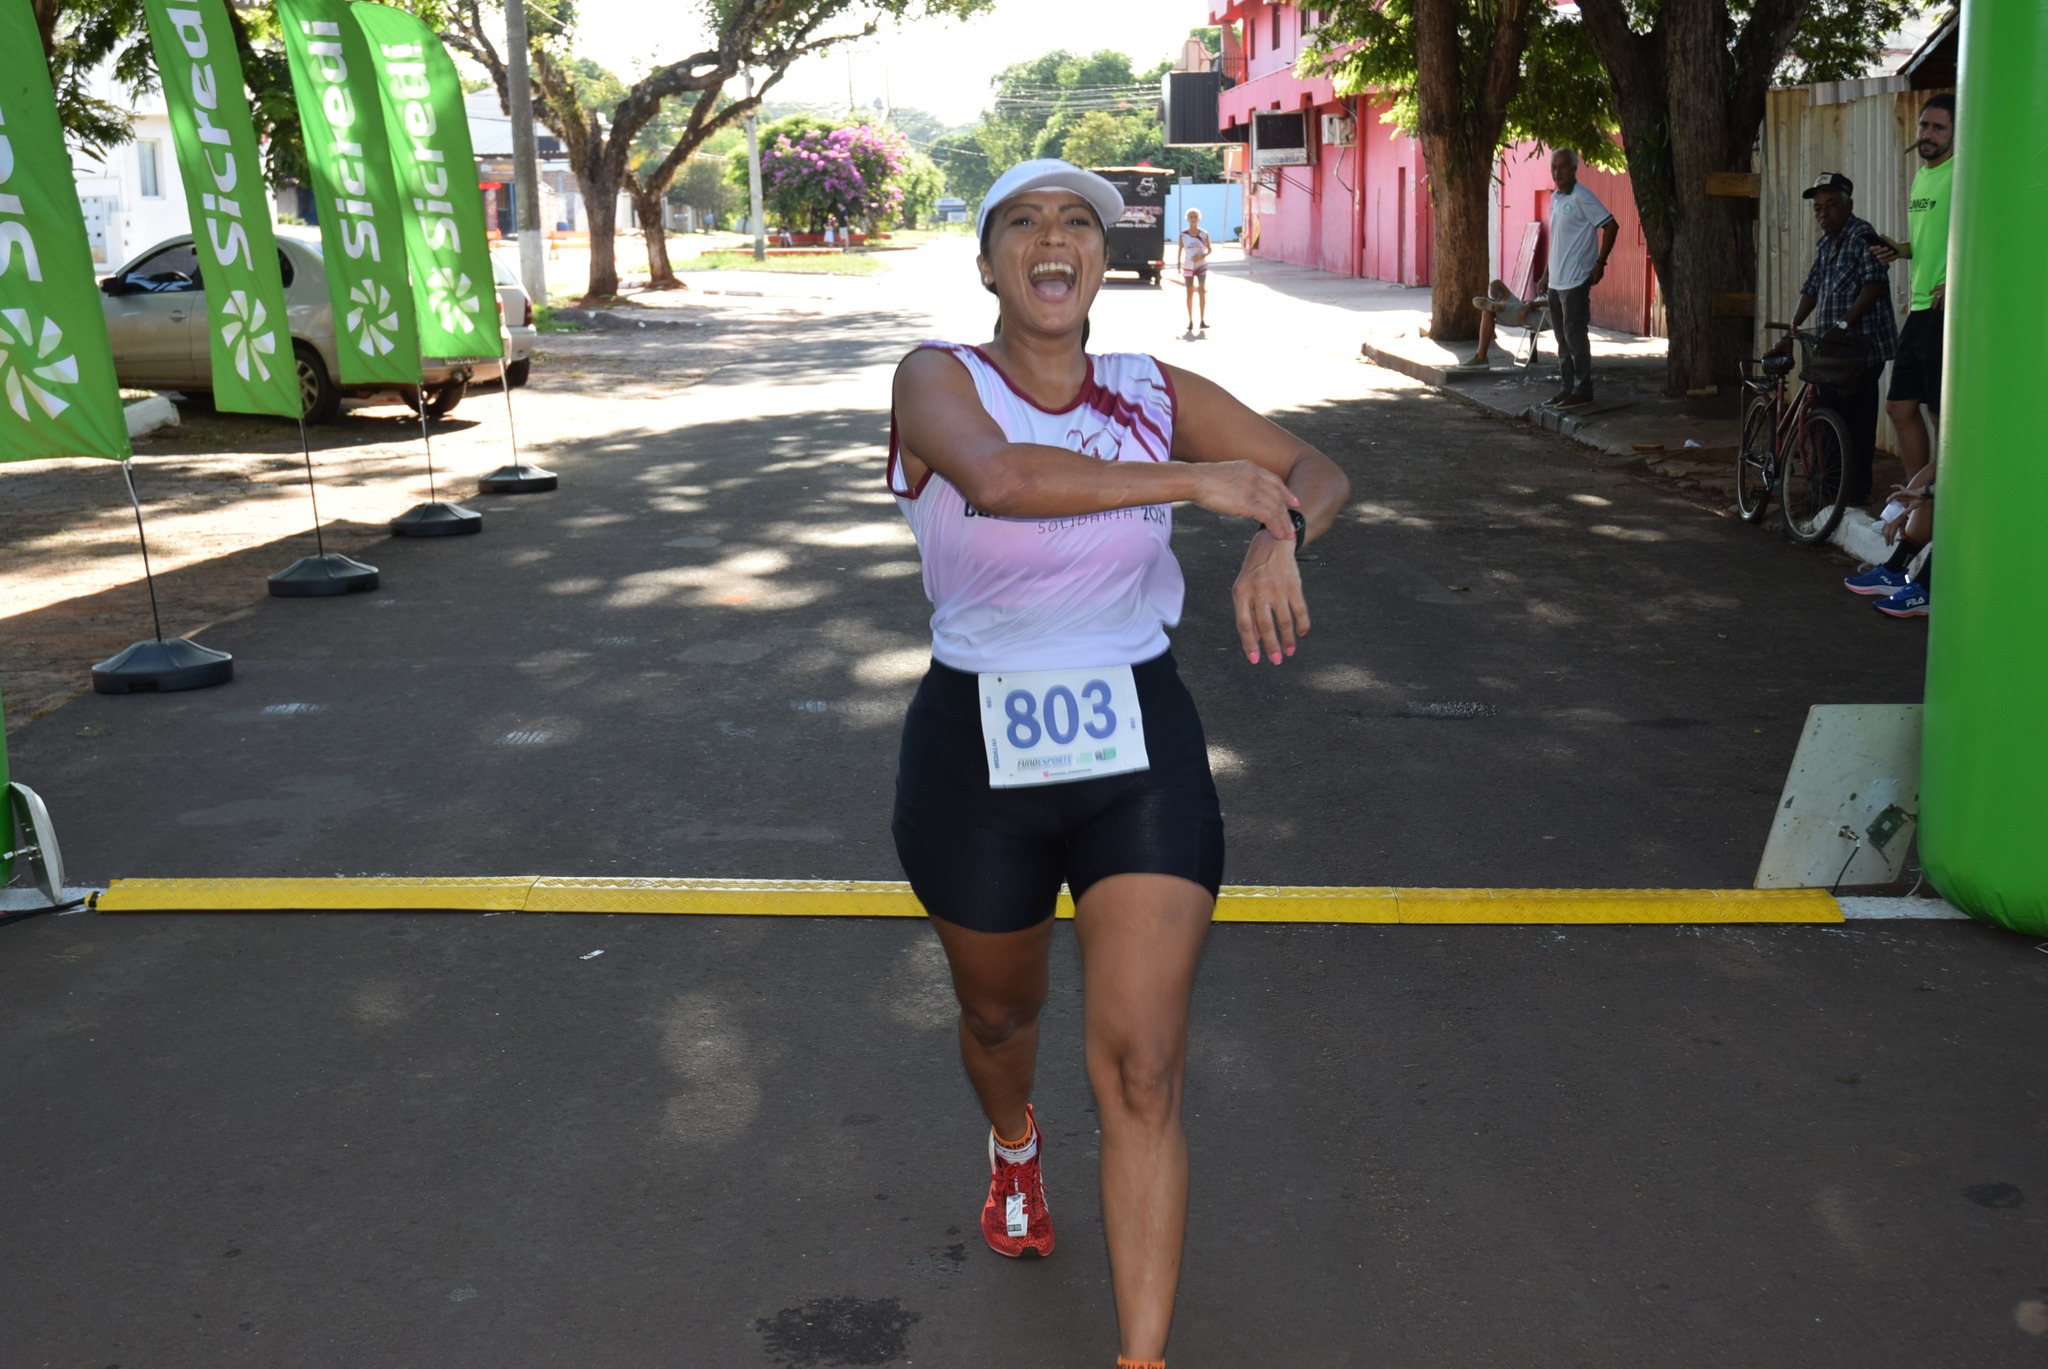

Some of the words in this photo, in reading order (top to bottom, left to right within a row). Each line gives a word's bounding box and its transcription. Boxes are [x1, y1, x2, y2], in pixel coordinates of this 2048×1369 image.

[166, 0, 254, 271] Sicred
[300, 20, 381, 262] Sicredi
[380, 40, 461, 253] Sicredi
[1905, 597, 1925, 608] FILA
[1004, 678, 1117, 749] 803
